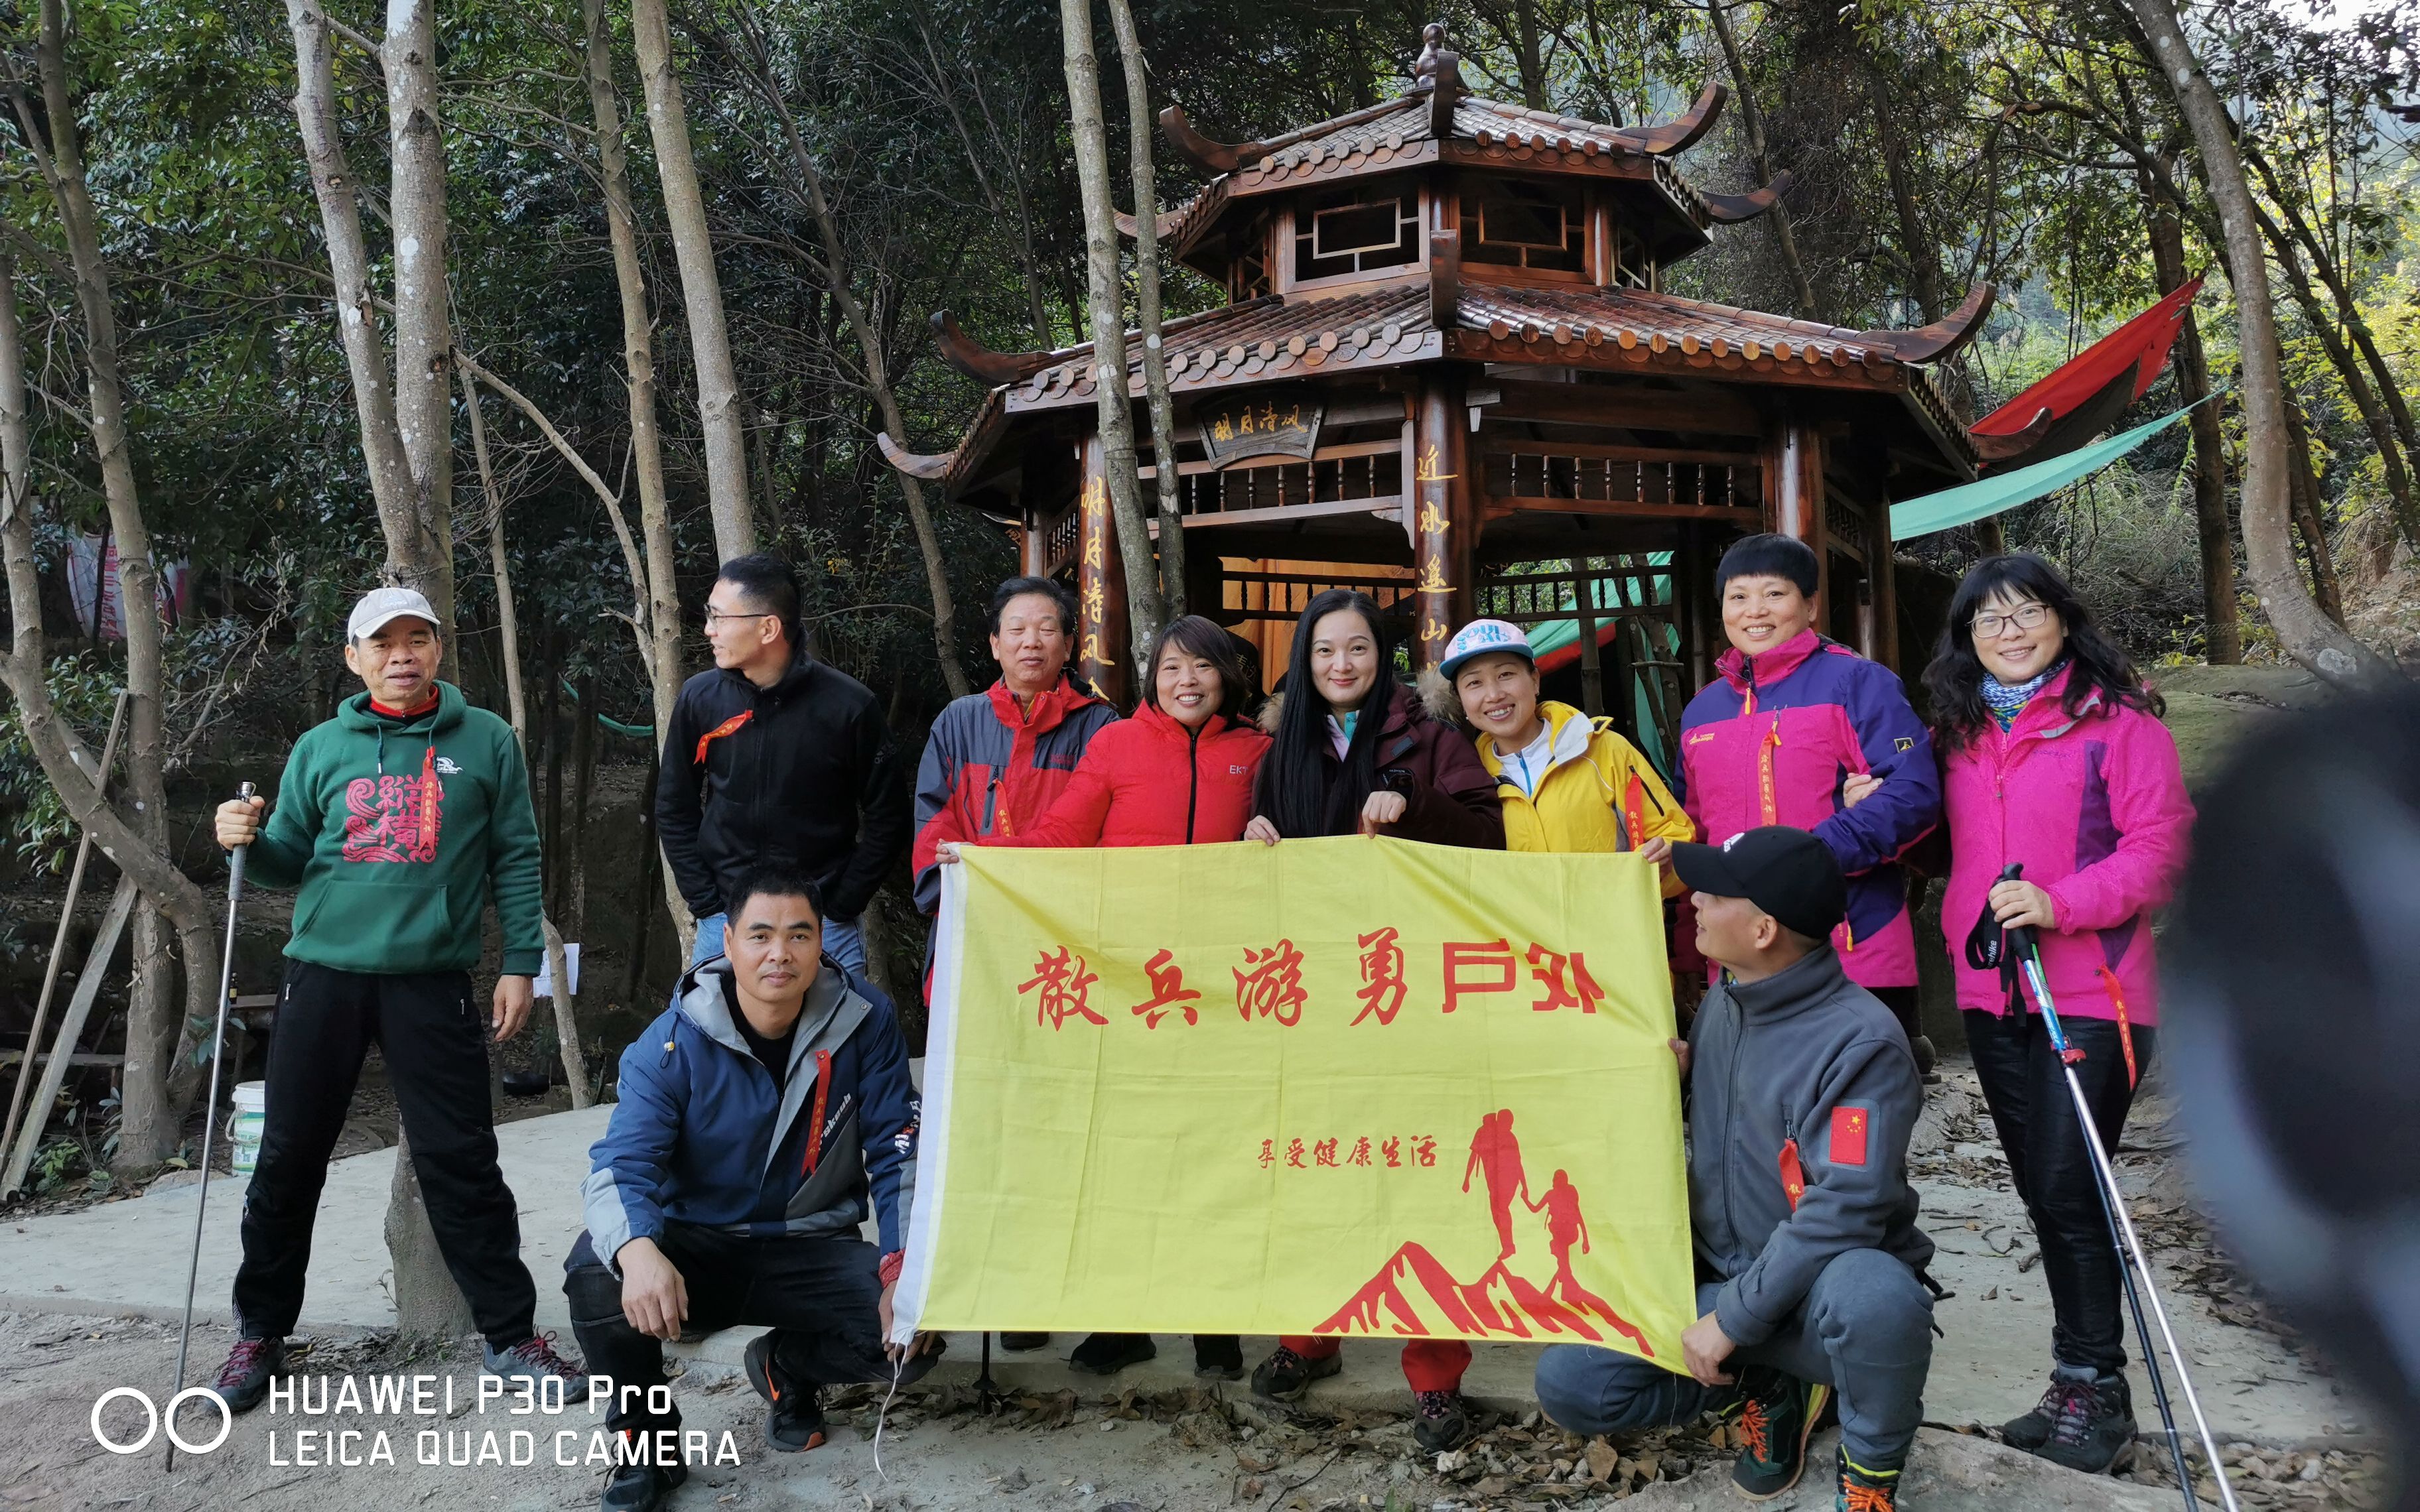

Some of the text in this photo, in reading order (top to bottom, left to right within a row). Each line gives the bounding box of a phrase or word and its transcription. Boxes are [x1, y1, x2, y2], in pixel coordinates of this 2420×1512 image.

[1258, 1135, 1437, 1169] 享受健康生活
